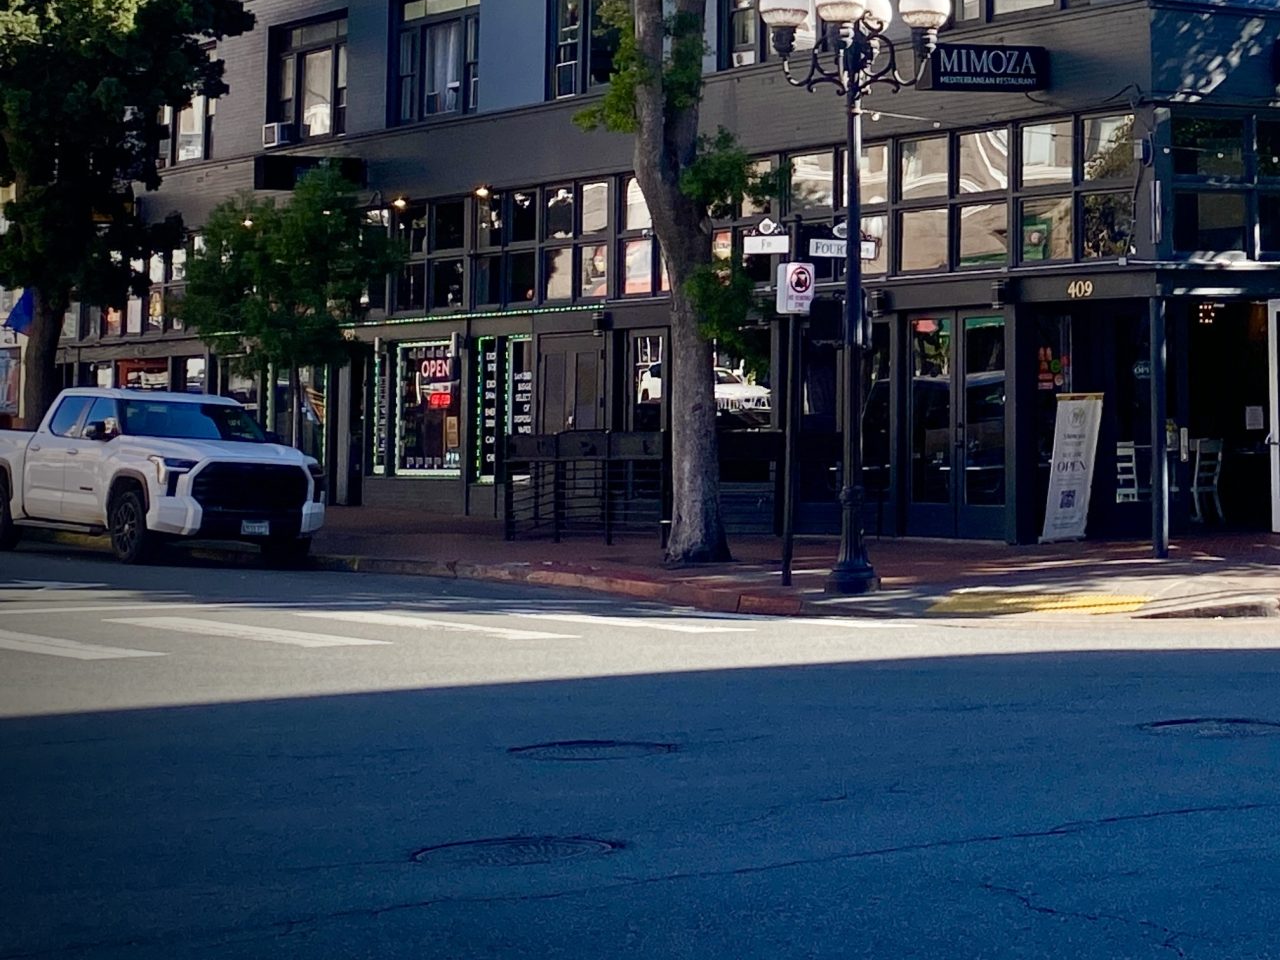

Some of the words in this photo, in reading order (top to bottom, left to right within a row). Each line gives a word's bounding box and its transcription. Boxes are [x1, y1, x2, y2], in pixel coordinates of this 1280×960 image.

[940, 48, 1037, 75] MIMOZA
[940, 76, 995, 85] MEDITERRANEAN
[996, 77, 1037, 86] RESTAURANT
[1067, 280, 1093, 298] 409
[421, 358, 450, 378] OPEN
[1056, 460, 1087, 474] OPEN
